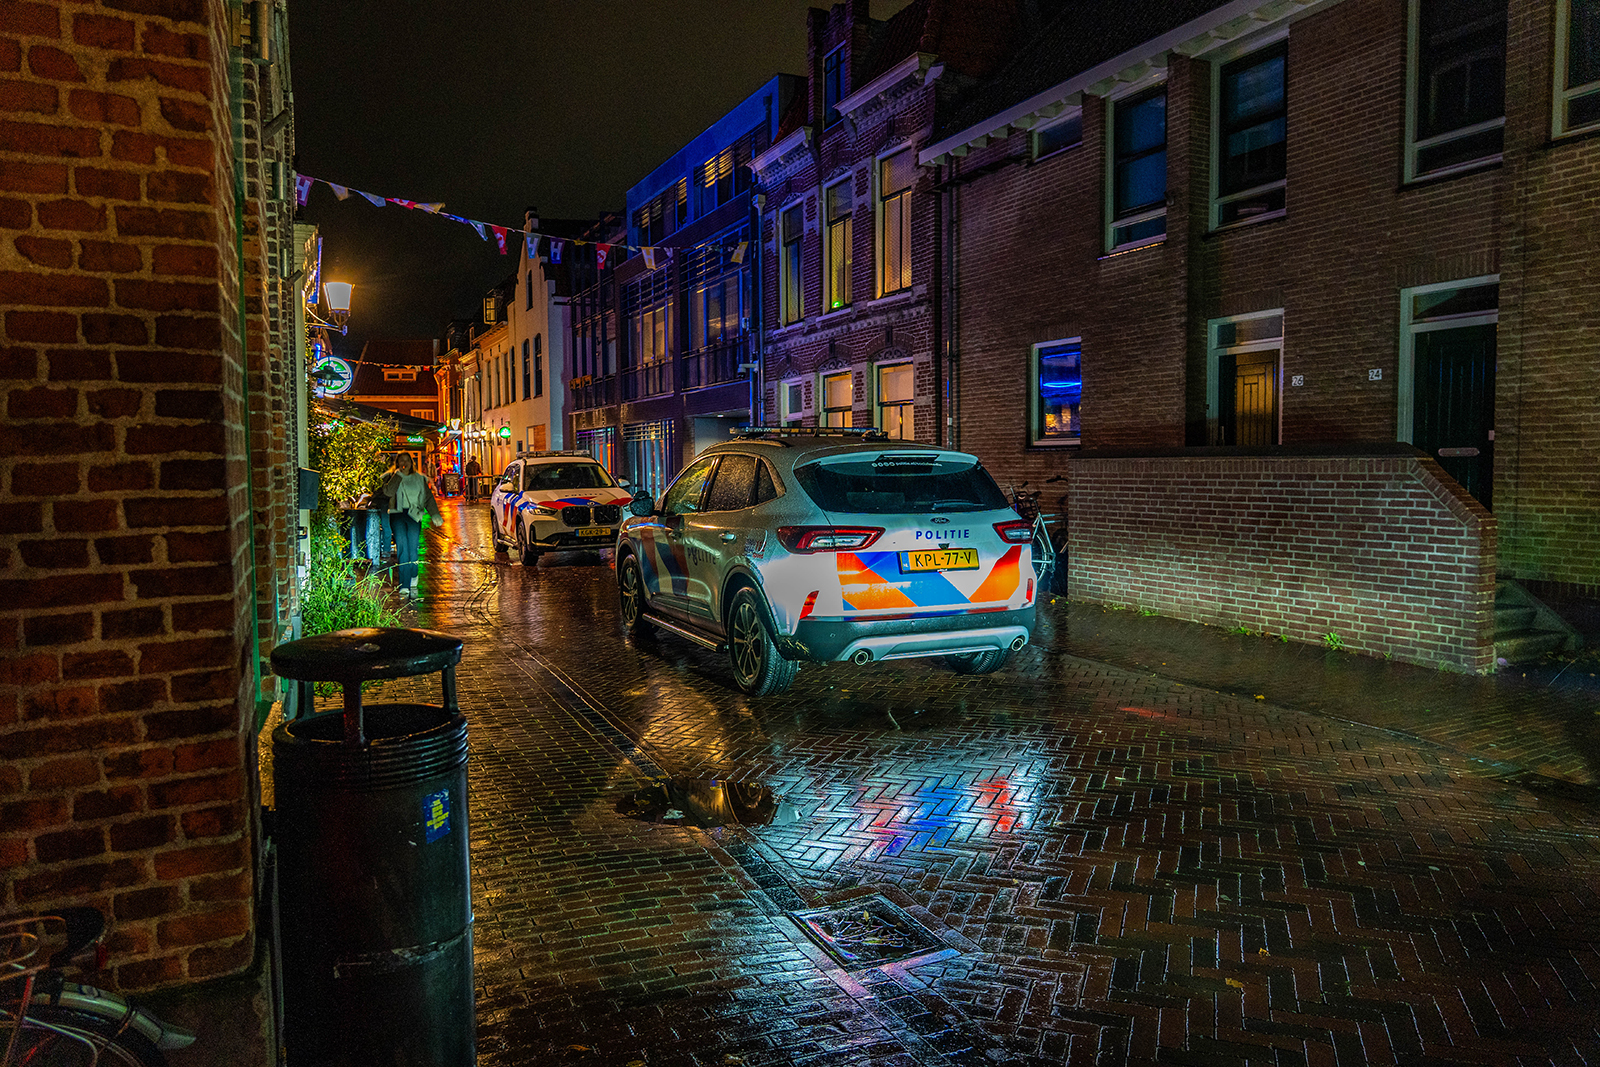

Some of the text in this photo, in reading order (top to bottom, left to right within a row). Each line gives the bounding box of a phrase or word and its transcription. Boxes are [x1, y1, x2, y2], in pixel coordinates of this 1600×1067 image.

[1370, 370, 1381, 379] 24
[1293, 376, 1303, 385] 26
[915, 529, 970, 540] POLITIE
[914, 551, 972, 568] KPL-77-V
